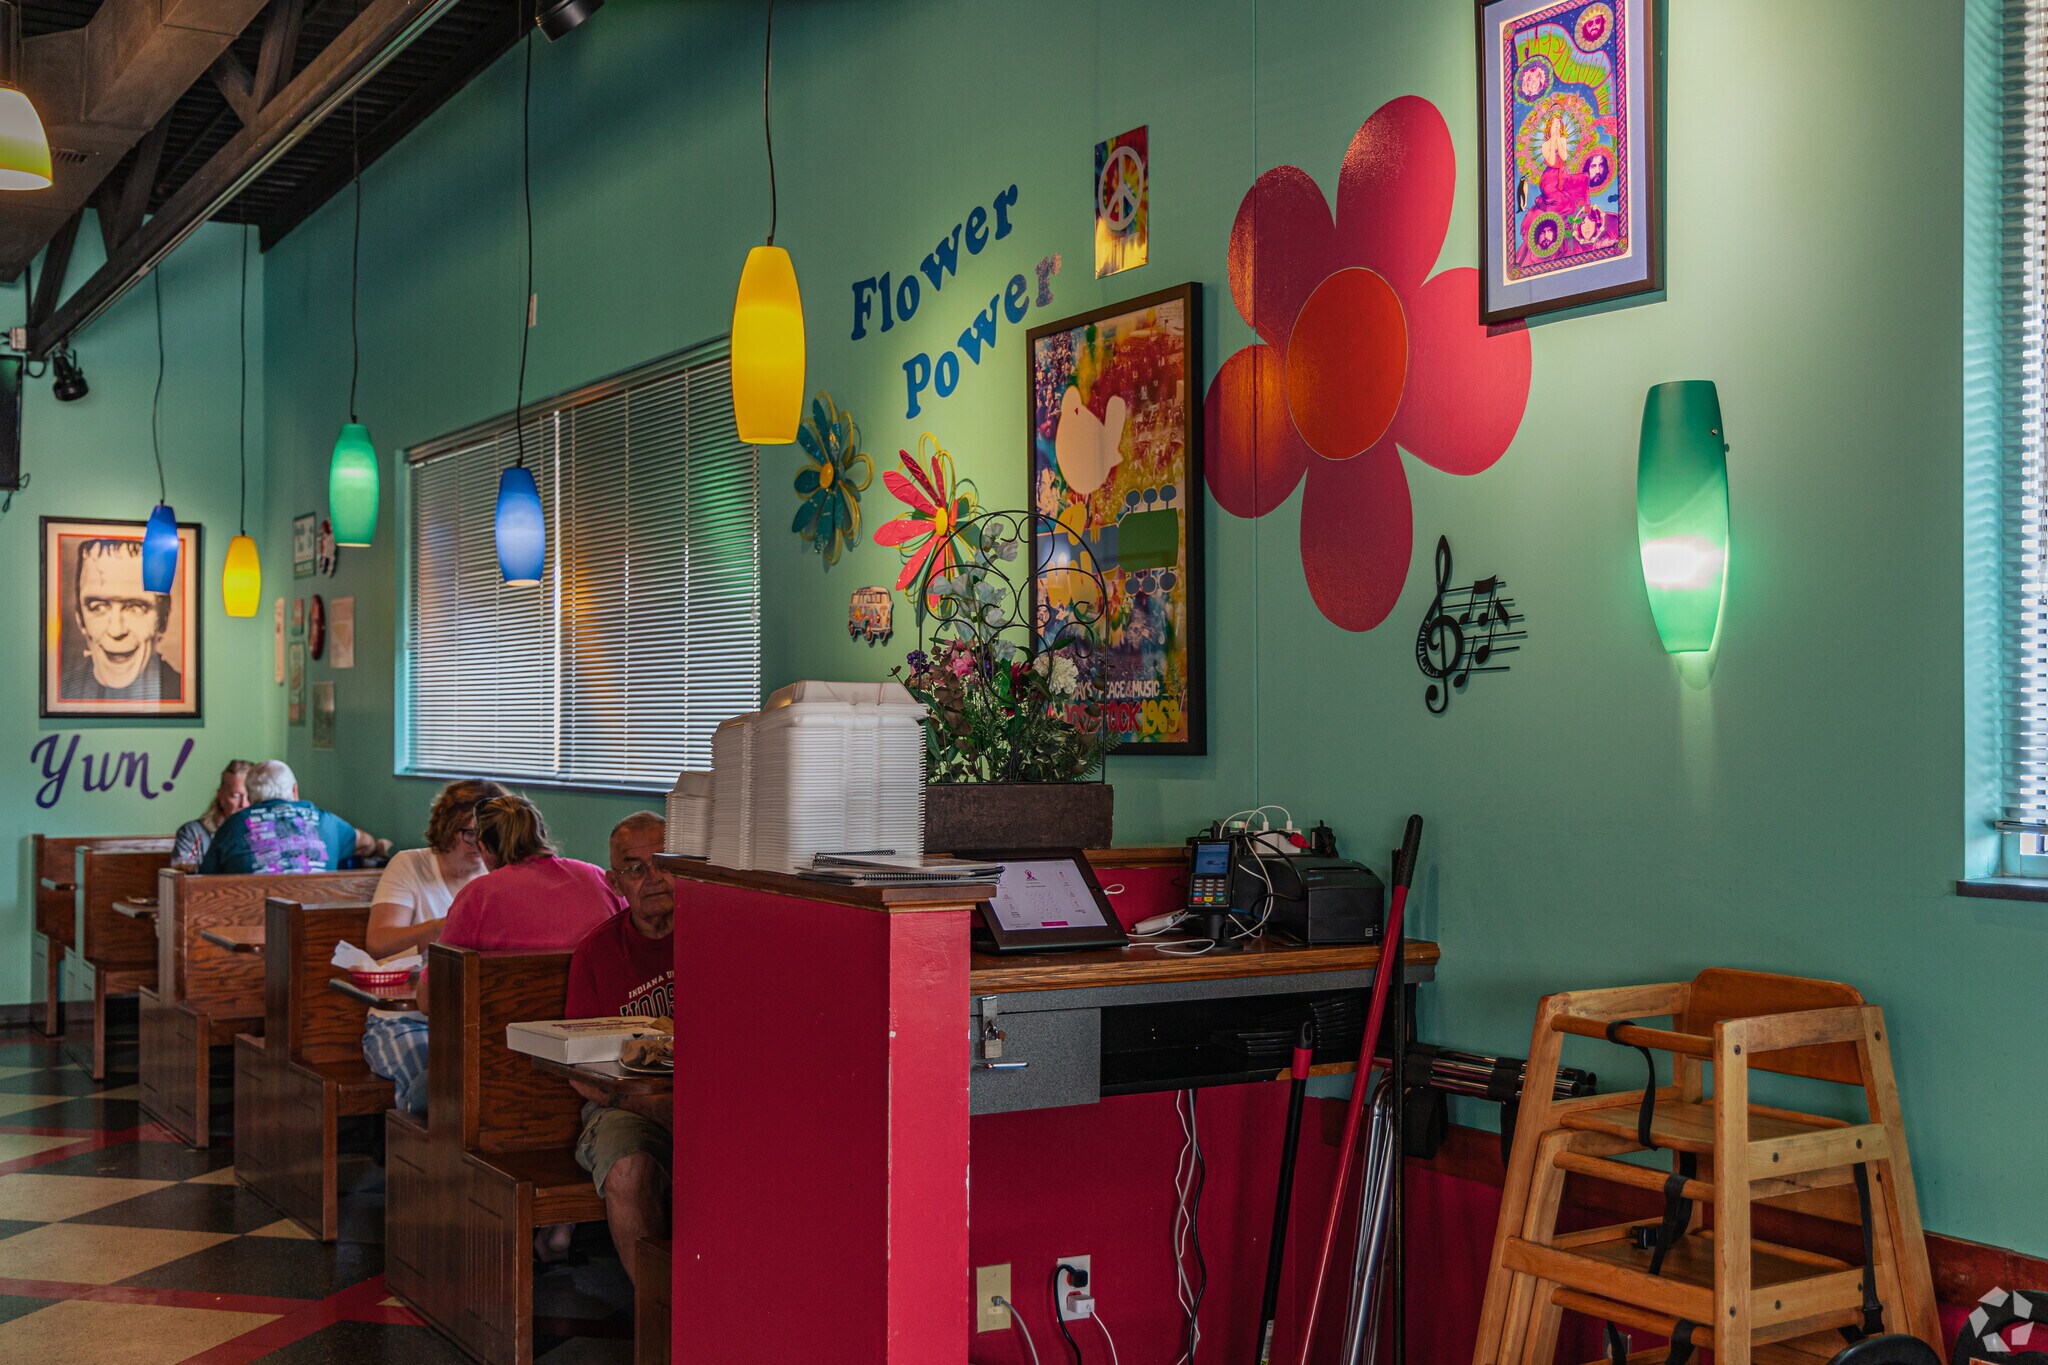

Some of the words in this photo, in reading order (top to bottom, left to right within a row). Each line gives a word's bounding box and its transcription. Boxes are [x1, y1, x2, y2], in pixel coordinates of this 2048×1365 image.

[1514, 23, 1612, 88] FLEETWOOD
[851, 184, 1018, 341] Flower
[902, 252, 1062, 419] Power
[1132, 680, 1160, 698] MUSIC
[1141, 699, 1180, 734] 1969
[30, 734, 194, 808] Yum!
[628, 975, 664, 999] INDIANA
